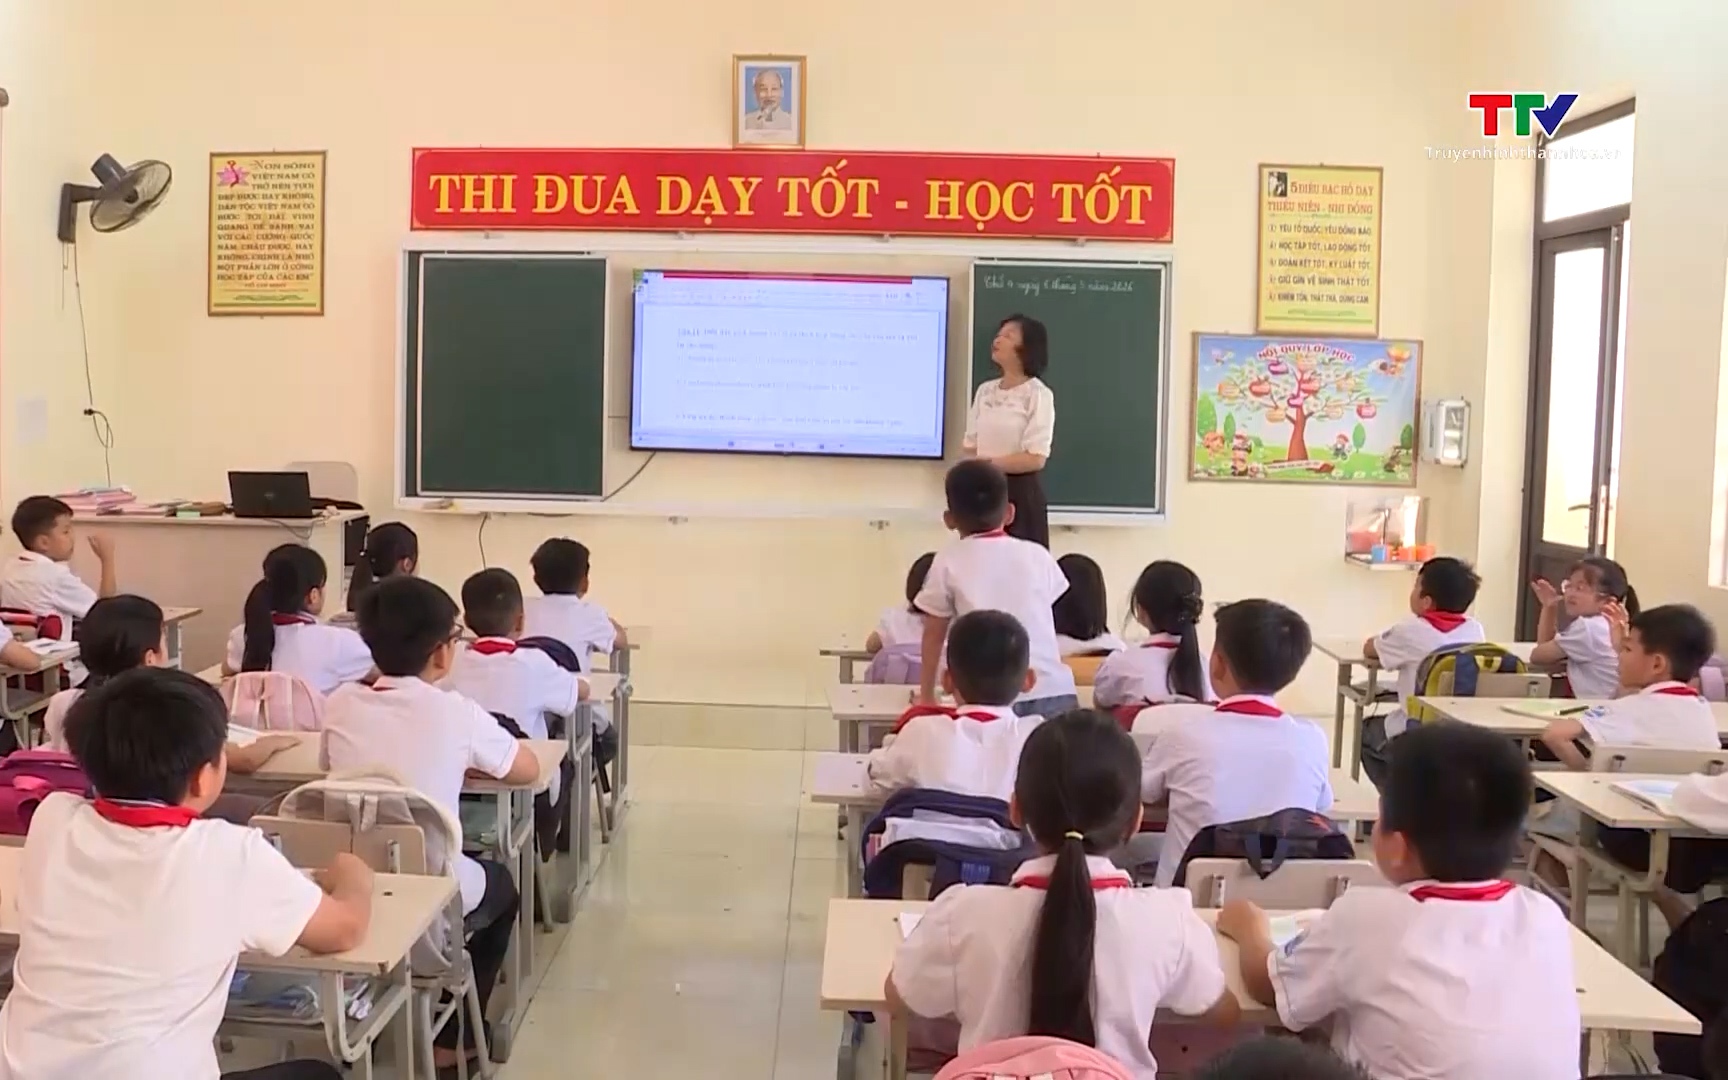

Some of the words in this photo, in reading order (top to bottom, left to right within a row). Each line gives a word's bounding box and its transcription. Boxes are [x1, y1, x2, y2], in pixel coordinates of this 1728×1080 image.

[1291, 181, 1298, 194] 5
[429, 174, 518, 213] THI
[532, 174, 640, 215] ĐUA
[656, 175, 763, 225] DẠY
[777, 159, 879, 218] TỐT
[895, 200, 908, 209] -
[925, 180, 1034, 231] HỌC
[1052, 165, 1152, 225] TỐT
[1324, 243, 1337, 251] LAO
